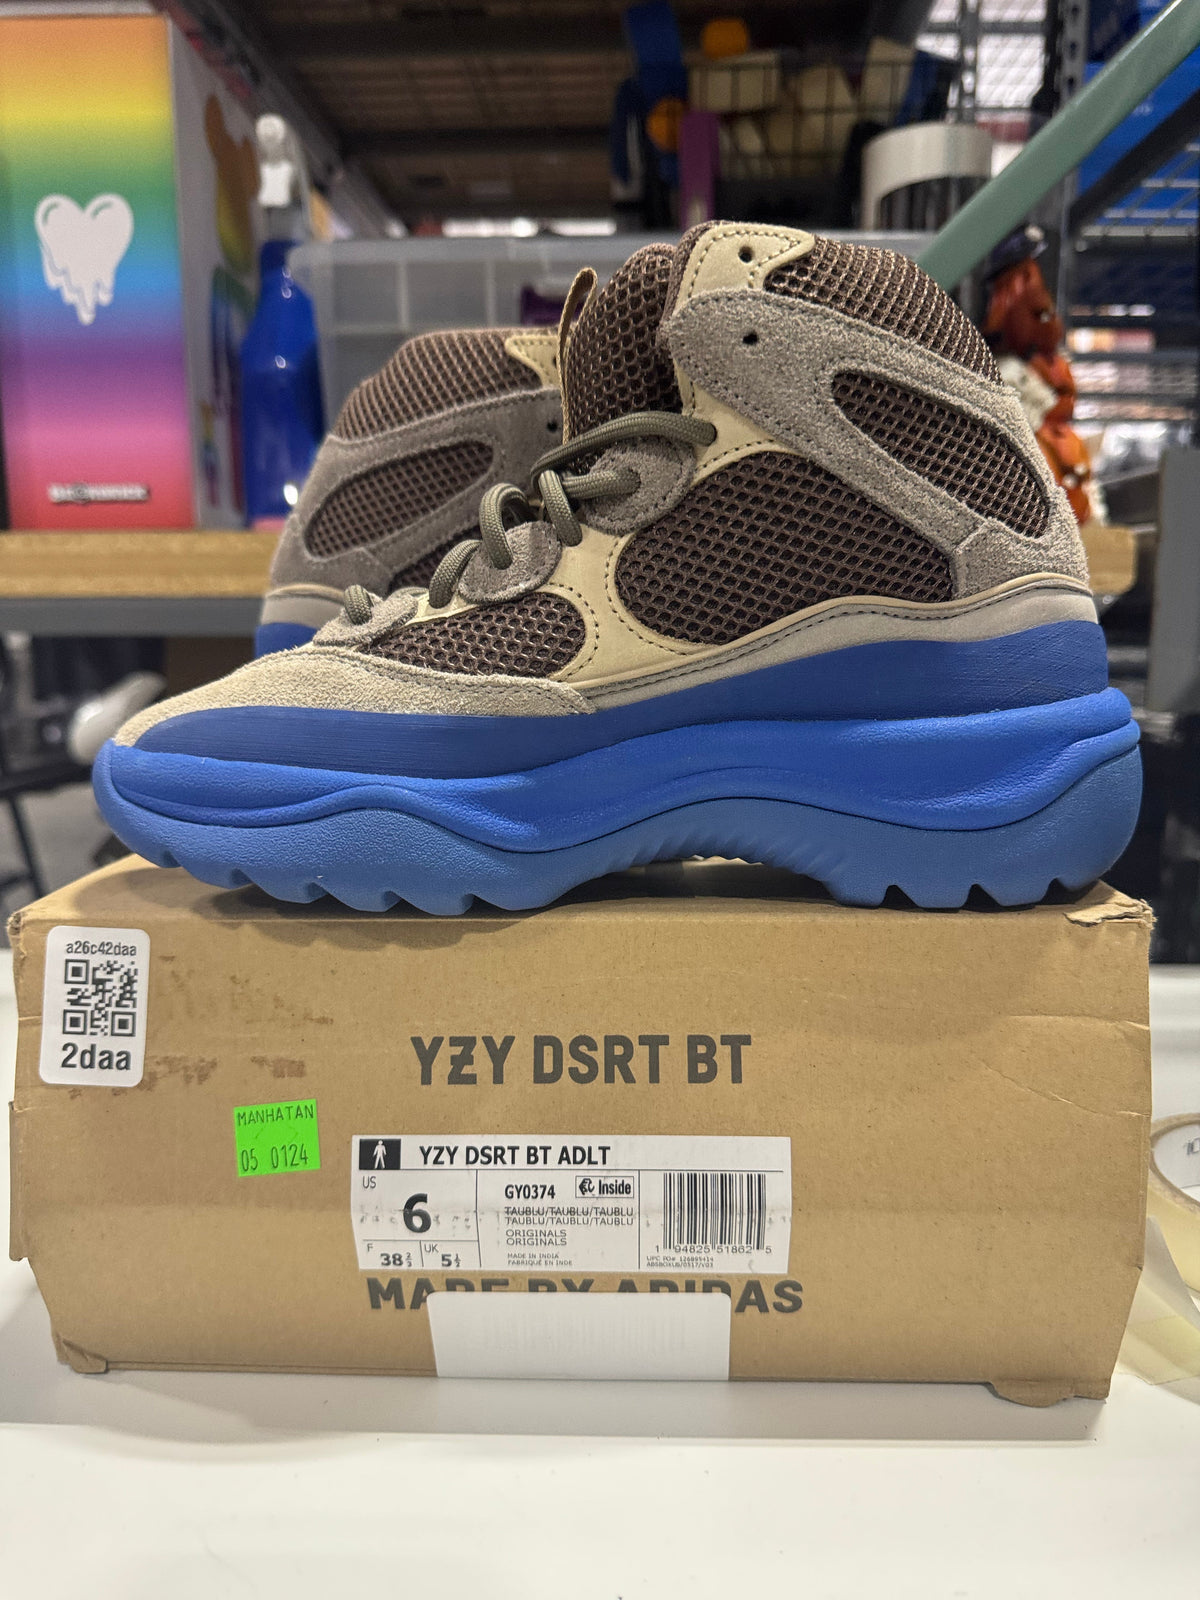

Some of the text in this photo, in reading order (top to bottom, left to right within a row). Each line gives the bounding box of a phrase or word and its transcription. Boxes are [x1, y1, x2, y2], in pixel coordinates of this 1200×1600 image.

[66, 940, 137, 956] a26c42daa
[61, 1042, 132, 1071] 2daa
[533, 1034, 670, 1084] DSRT
[687, 1034, 752, 1084] BT
[237, 1104, 314, 1127] MANHATAN
[241, 1143, 309, 1172] 05 0124
[419, 1145, 611, 1165] YZY DSRT BT ADLT
[362, 1175, 377, 1189] US
[598, 1179, 632, 1195] Inside
[504, 1184, 556, 1199] GY0374
[402, 1192, 432, 1234] 6
[504, 1217, 634, 1227] TAUBLU/TAUBLU/TAUBLU
[505, 1229, 567, 1238] ORIGINALS
[366, 1243, 374, 1252] F
[424, 1243, 439, 1253] UK
[506, 1238, 568, 1247] ORIGINALS
[544, 1259, 554, 1267] EN
